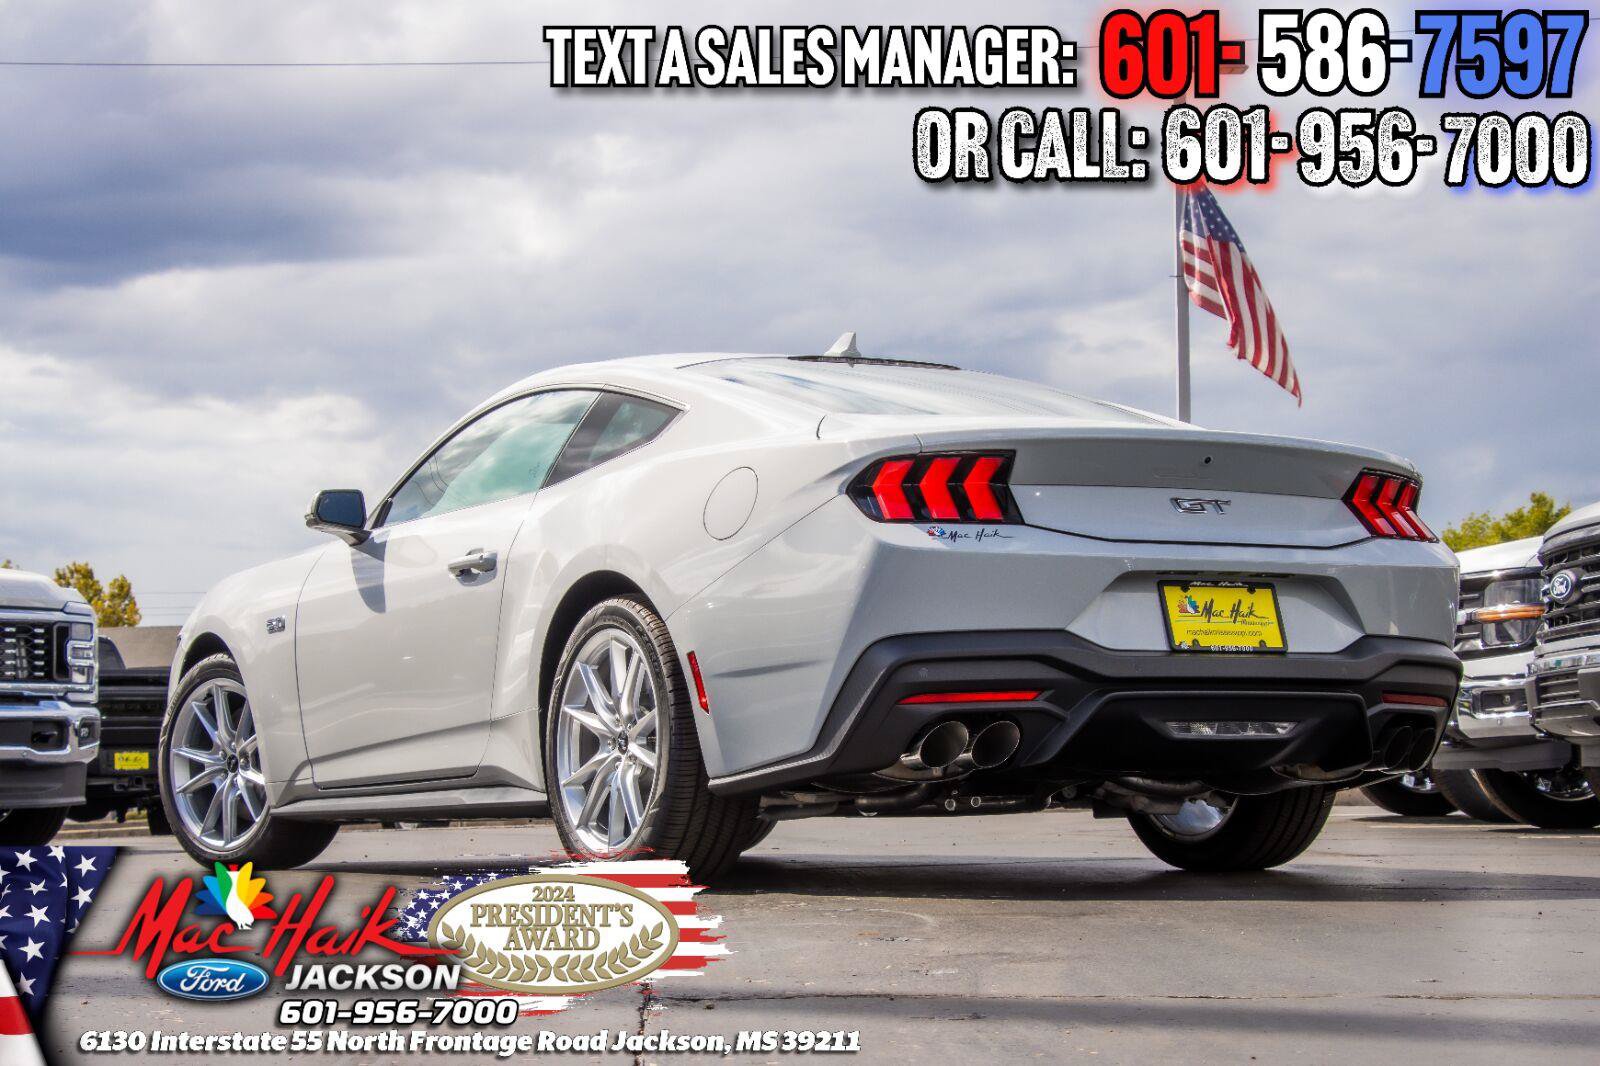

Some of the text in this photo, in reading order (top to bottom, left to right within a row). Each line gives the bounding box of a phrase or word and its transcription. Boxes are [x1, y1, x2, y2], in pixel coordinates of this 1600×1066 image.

[1170, 497, 1231, 514] GT
[946, 523, 1013, 542] Mac Haik
[1199, 598, 1267, 624] Mac Haik
